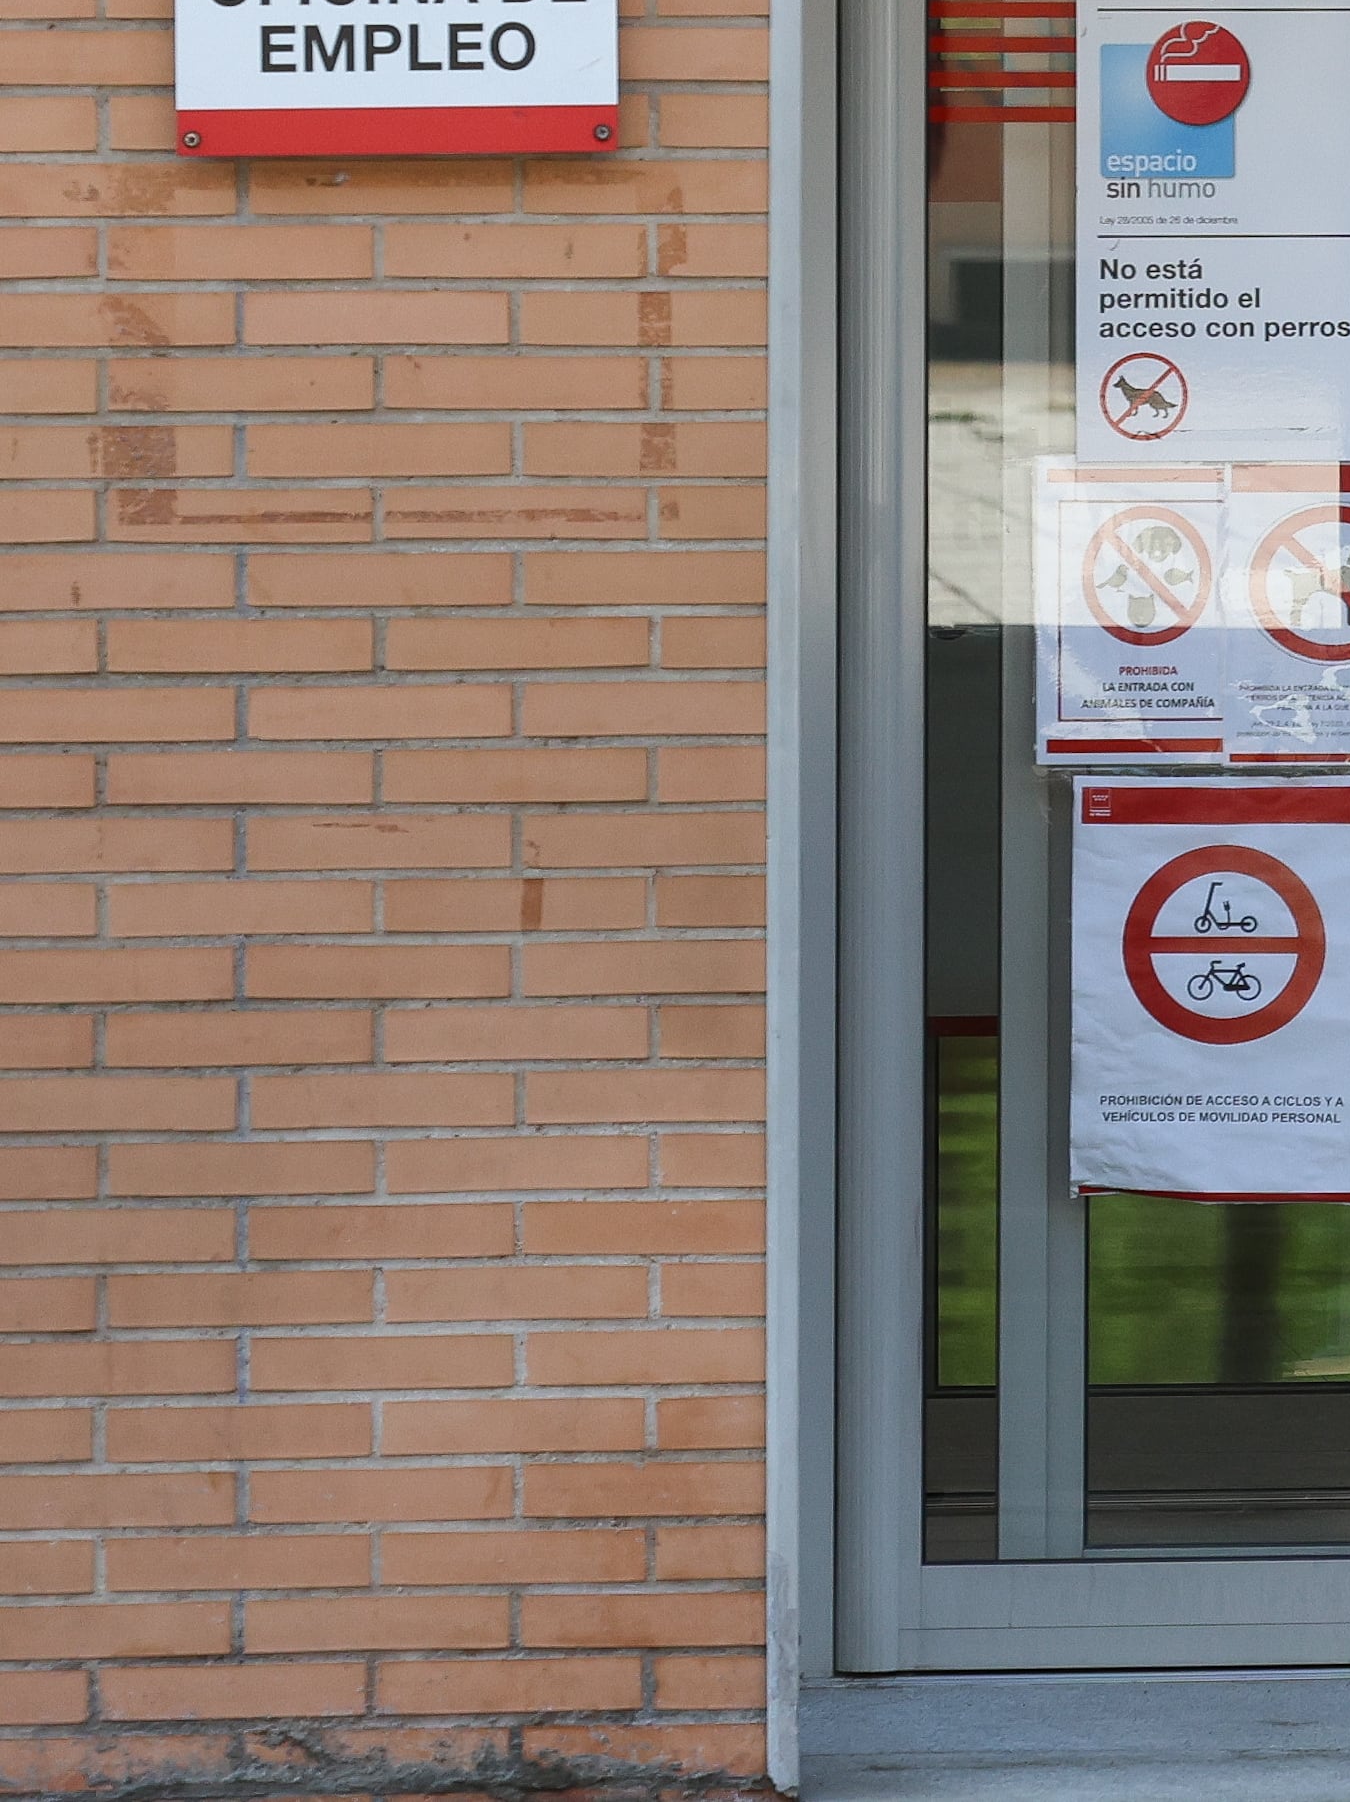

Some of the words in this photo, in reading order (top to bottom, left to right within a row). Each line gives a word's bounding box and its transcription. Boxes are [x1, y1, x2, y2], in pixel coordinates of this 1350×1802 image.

[261, 21, 536, 73] EMPLEO
[1107, 150, 1197, 177] espacio
[1106, 178, 1140, 199] sin
[1148, 178, 1215, 199] humo
[1183, 216, 1194, 224] de
[1099, 260, 1136, 280] No
[1146, 258, 1202, 280] está
[1099, 288, 1228, 313] permitido
[1238, 288, 1260, 309] el
[1100, 320, 1196, 338] acceso
[1206, 320, 1254, 337] con
[1264, 320, 1350, 341] perros
[1119, 666, 1178, 676] PROHIBIDA
[1102, 682, 1115, 692] LA
[1118, 682, 1168, 692] ENTRADA
[1171, 682, 1194, 692] CON
[1139, 699, 1152, 708] DE
[1156, 696, 1215, 708] COMPAÑÍA
[1100, 1093, 1183, 1106] PROHIBICIÓN
[1186, 1095, 1203, 1106] DE
[1205, 1095, 1259, 1107] ACCESO
[1261, 1095, 1271, 1107] A
[1273, 1095, 1322, 1107] CICLOS
[1324, 1096, 1332, 1107] Y
[1334, 1096, 1344, 1107] A
[1102, 1110, 1175, 1123] VEHÍCULOS
[1178, 1112, 1196, 1122] DE
[1198, 1112, 1269, 1123] MOVILIDAD
[1271, 1112, 1340, 1123] PERSONAL
